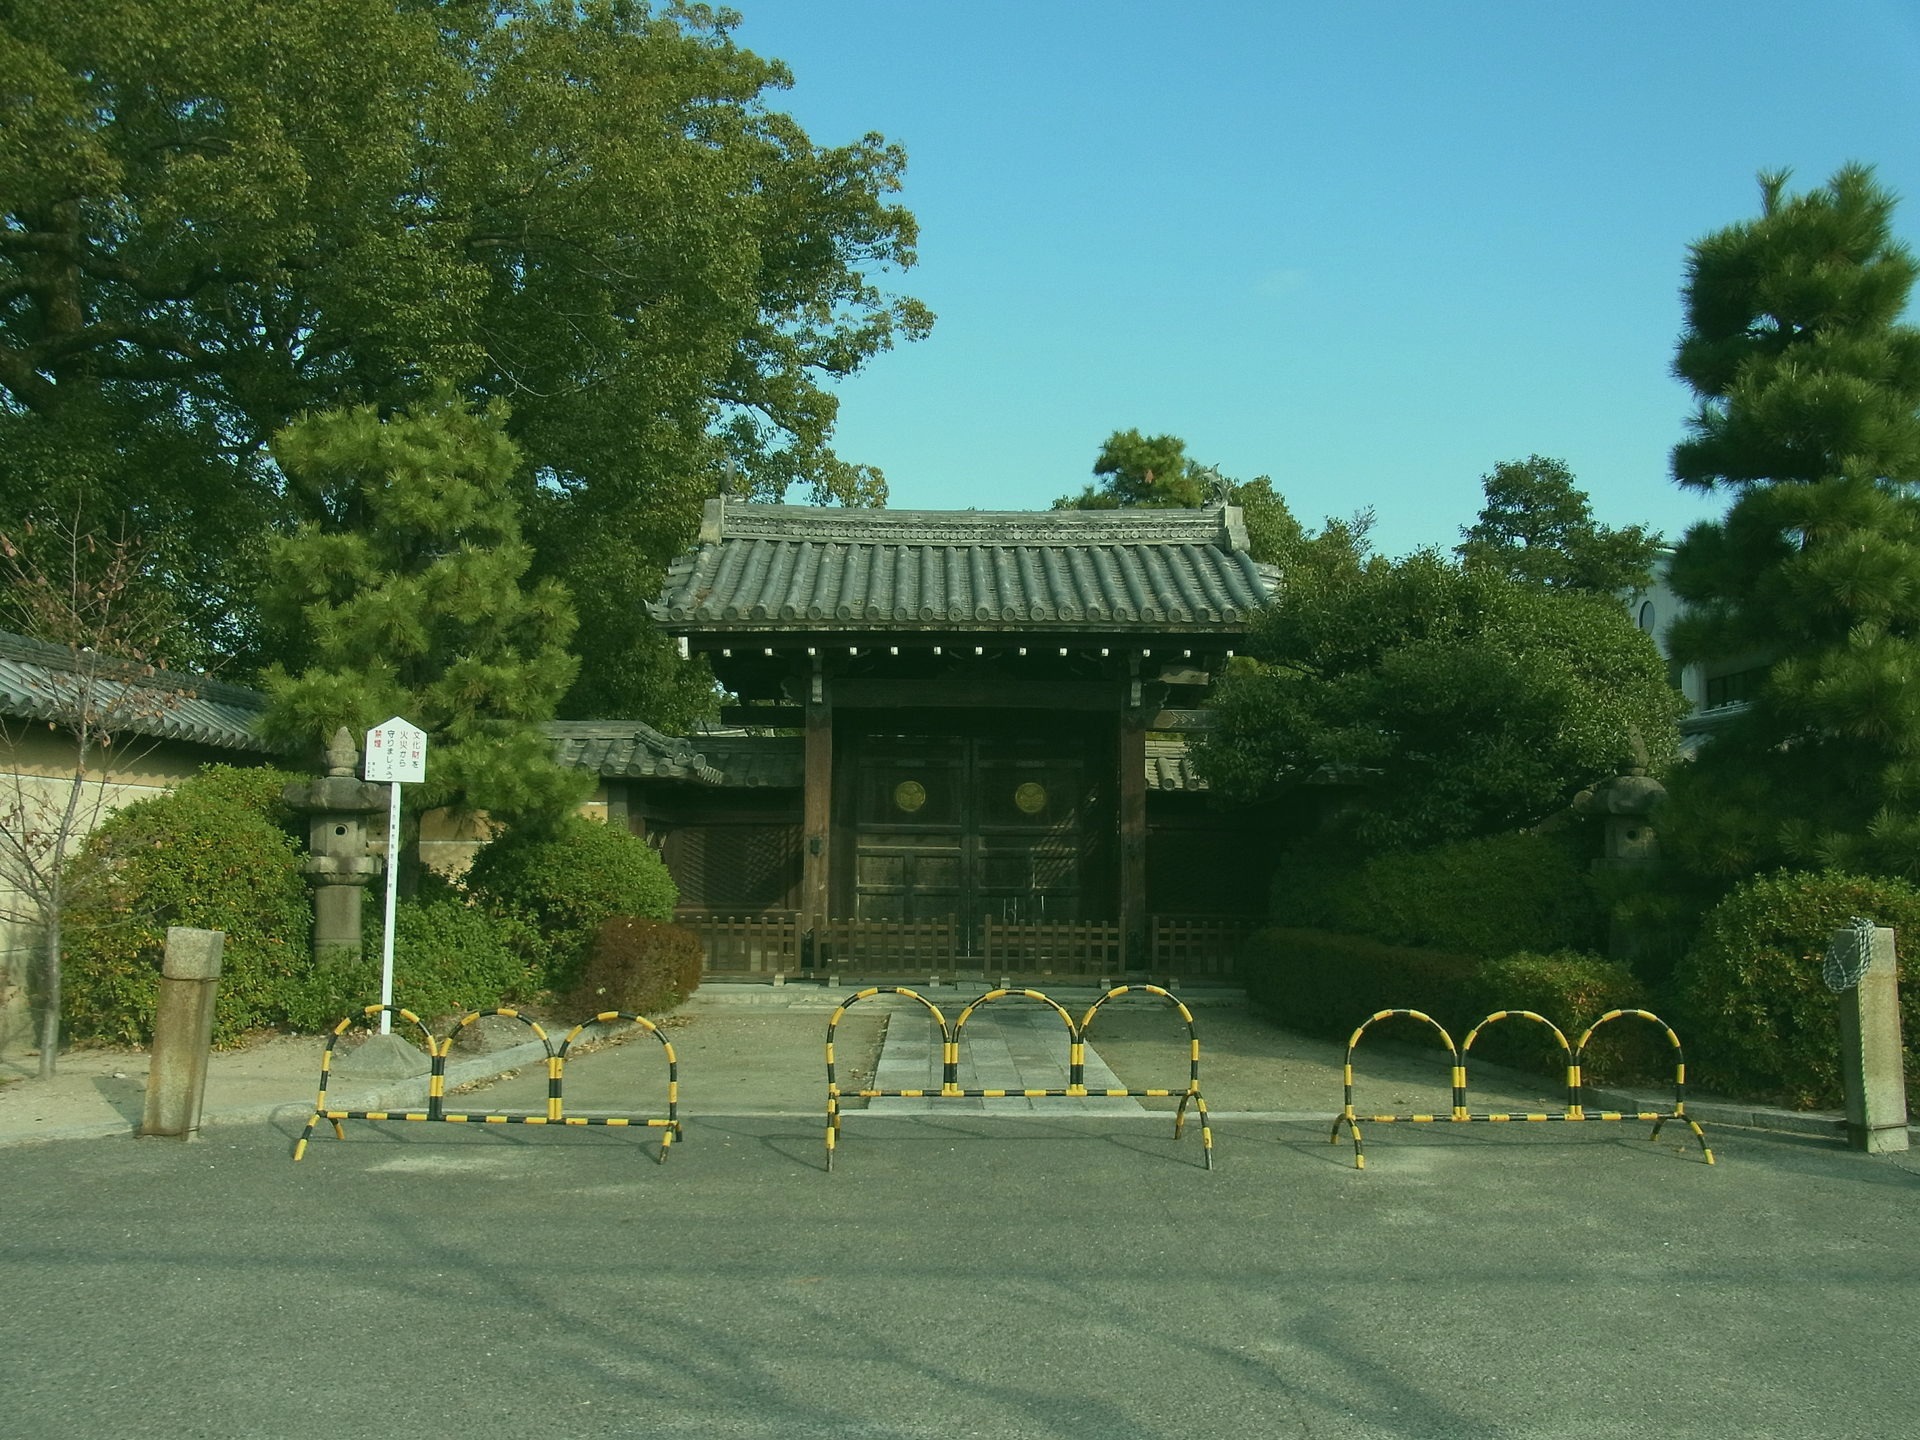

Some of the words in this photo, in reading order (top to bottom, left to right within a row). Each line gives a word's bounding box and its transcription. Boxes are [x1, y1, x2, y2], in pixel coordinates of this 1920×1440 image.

[386, 730, 395, 779] 守りましょう
[400, 731, 408, 768] 火災から
